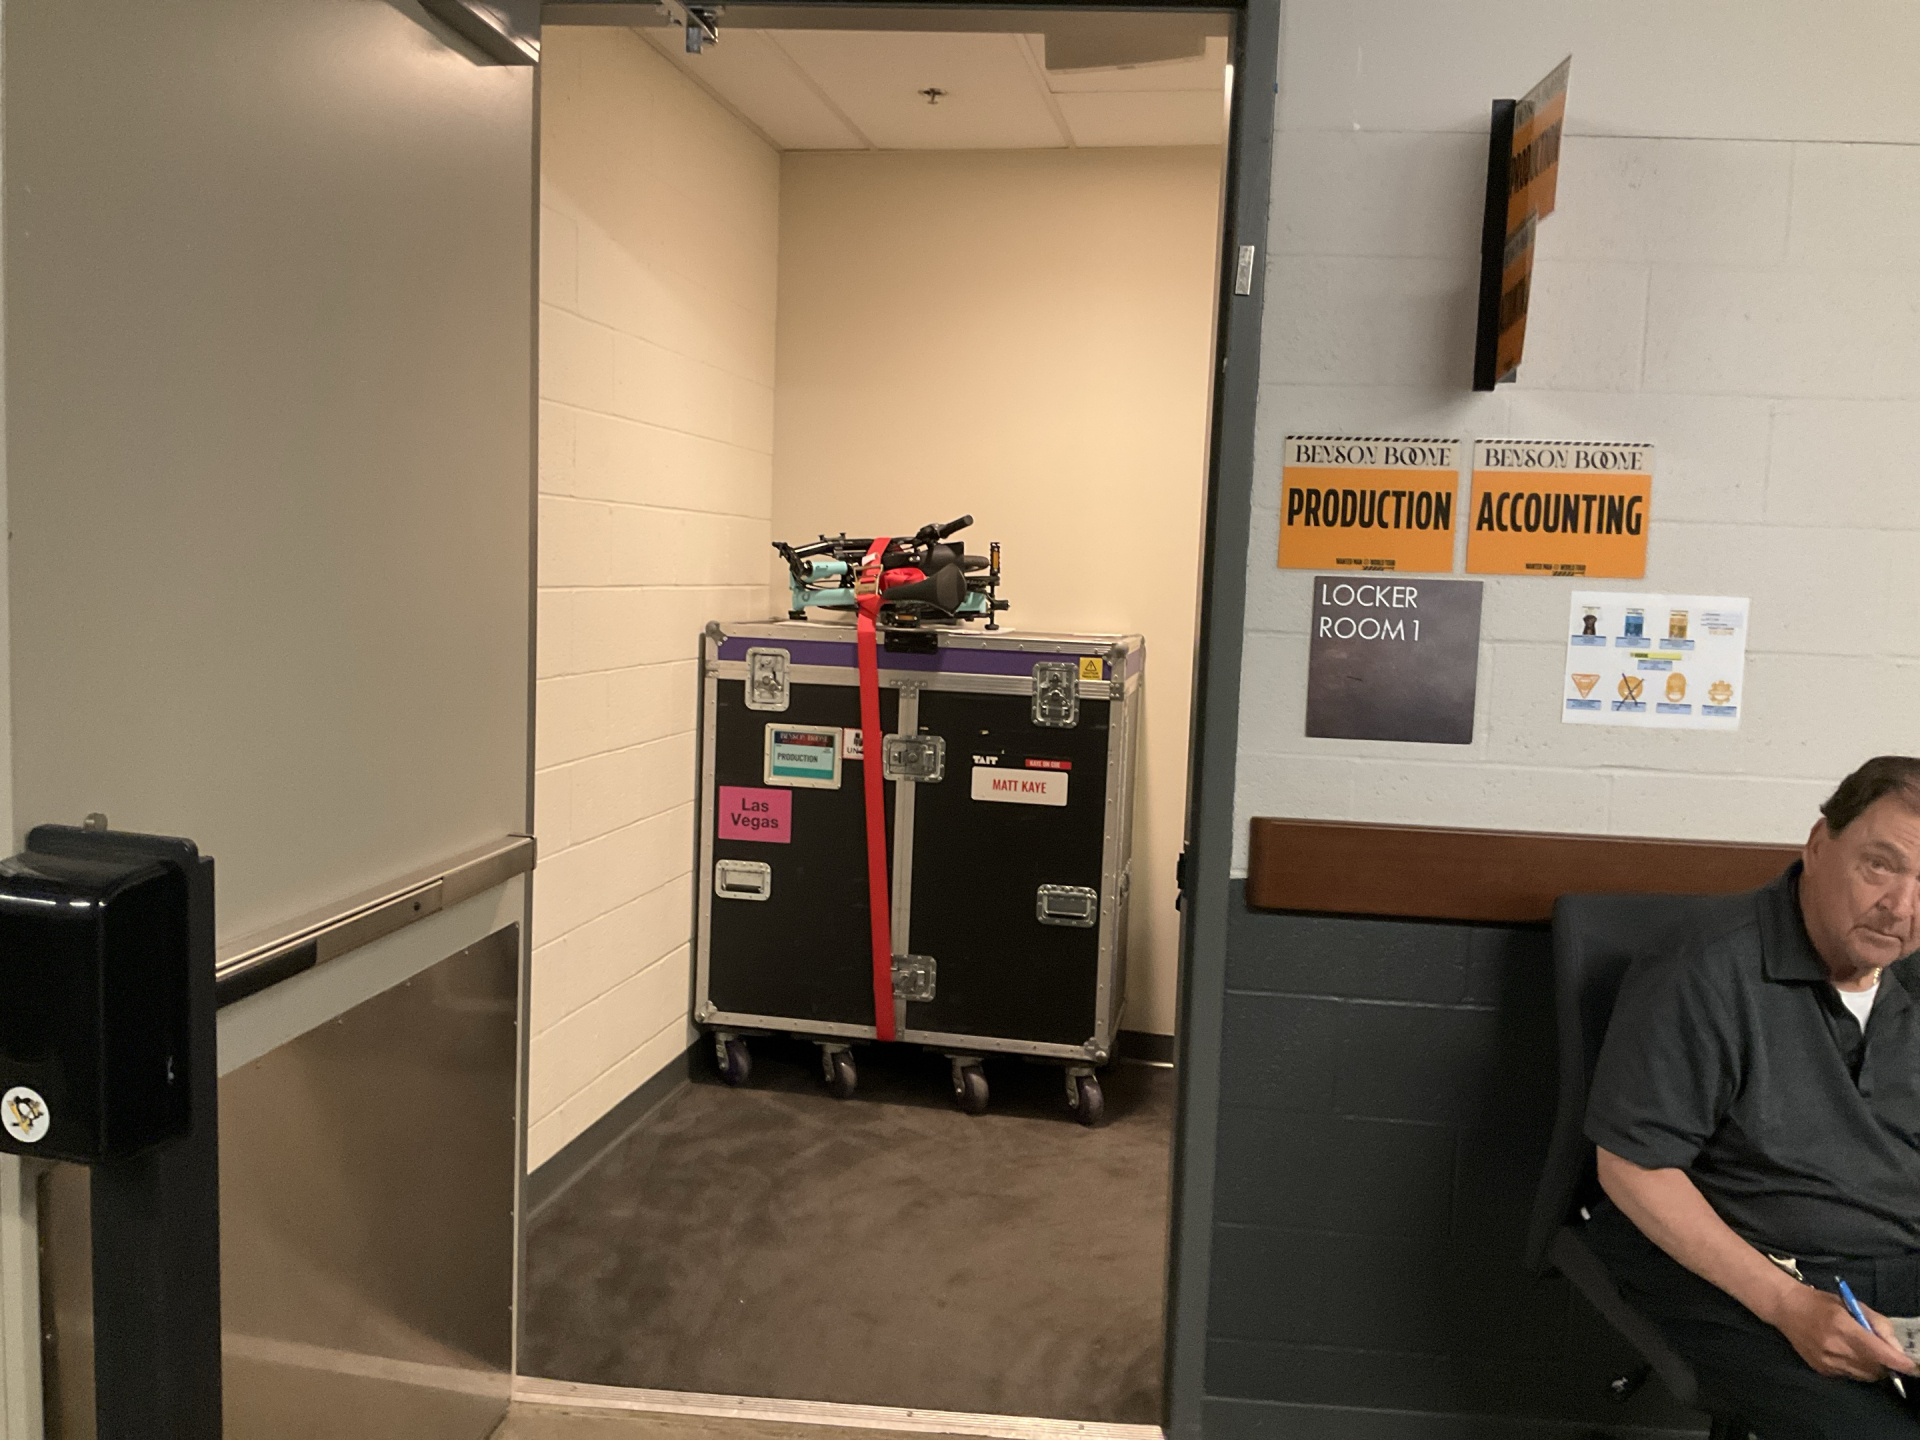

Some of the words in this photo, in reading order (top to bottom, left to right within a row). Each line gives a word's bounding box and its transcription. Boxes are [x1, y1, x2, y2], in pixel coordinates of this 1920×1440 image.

[1295, 444, 1377, 466] BENSON
[1384, 446, 1451, 467] BOONE
[1485, 448, 1568, 468] BENSON
[1575, 450, 1642, 471] BOONE
[1287, 488, 1452, 531] PRODUCTION
[1476, 491, 1643, 536] ACCOUNTING
[1322, 583, 1418, 608] LOCKER
[1319, 616, 1405, 641] ROOM
[1413, 619, 1419, 641] 1
[777, 752, 818, 763] PRODUCTION
[972, 755, 998, 765] TAIT
[992, 778, 1018, 792] MATT
[1021, 780, 1046, 794] KAYE
[742, 797, 769, 812] Las
[731, 812, 779, 831] Vegas
